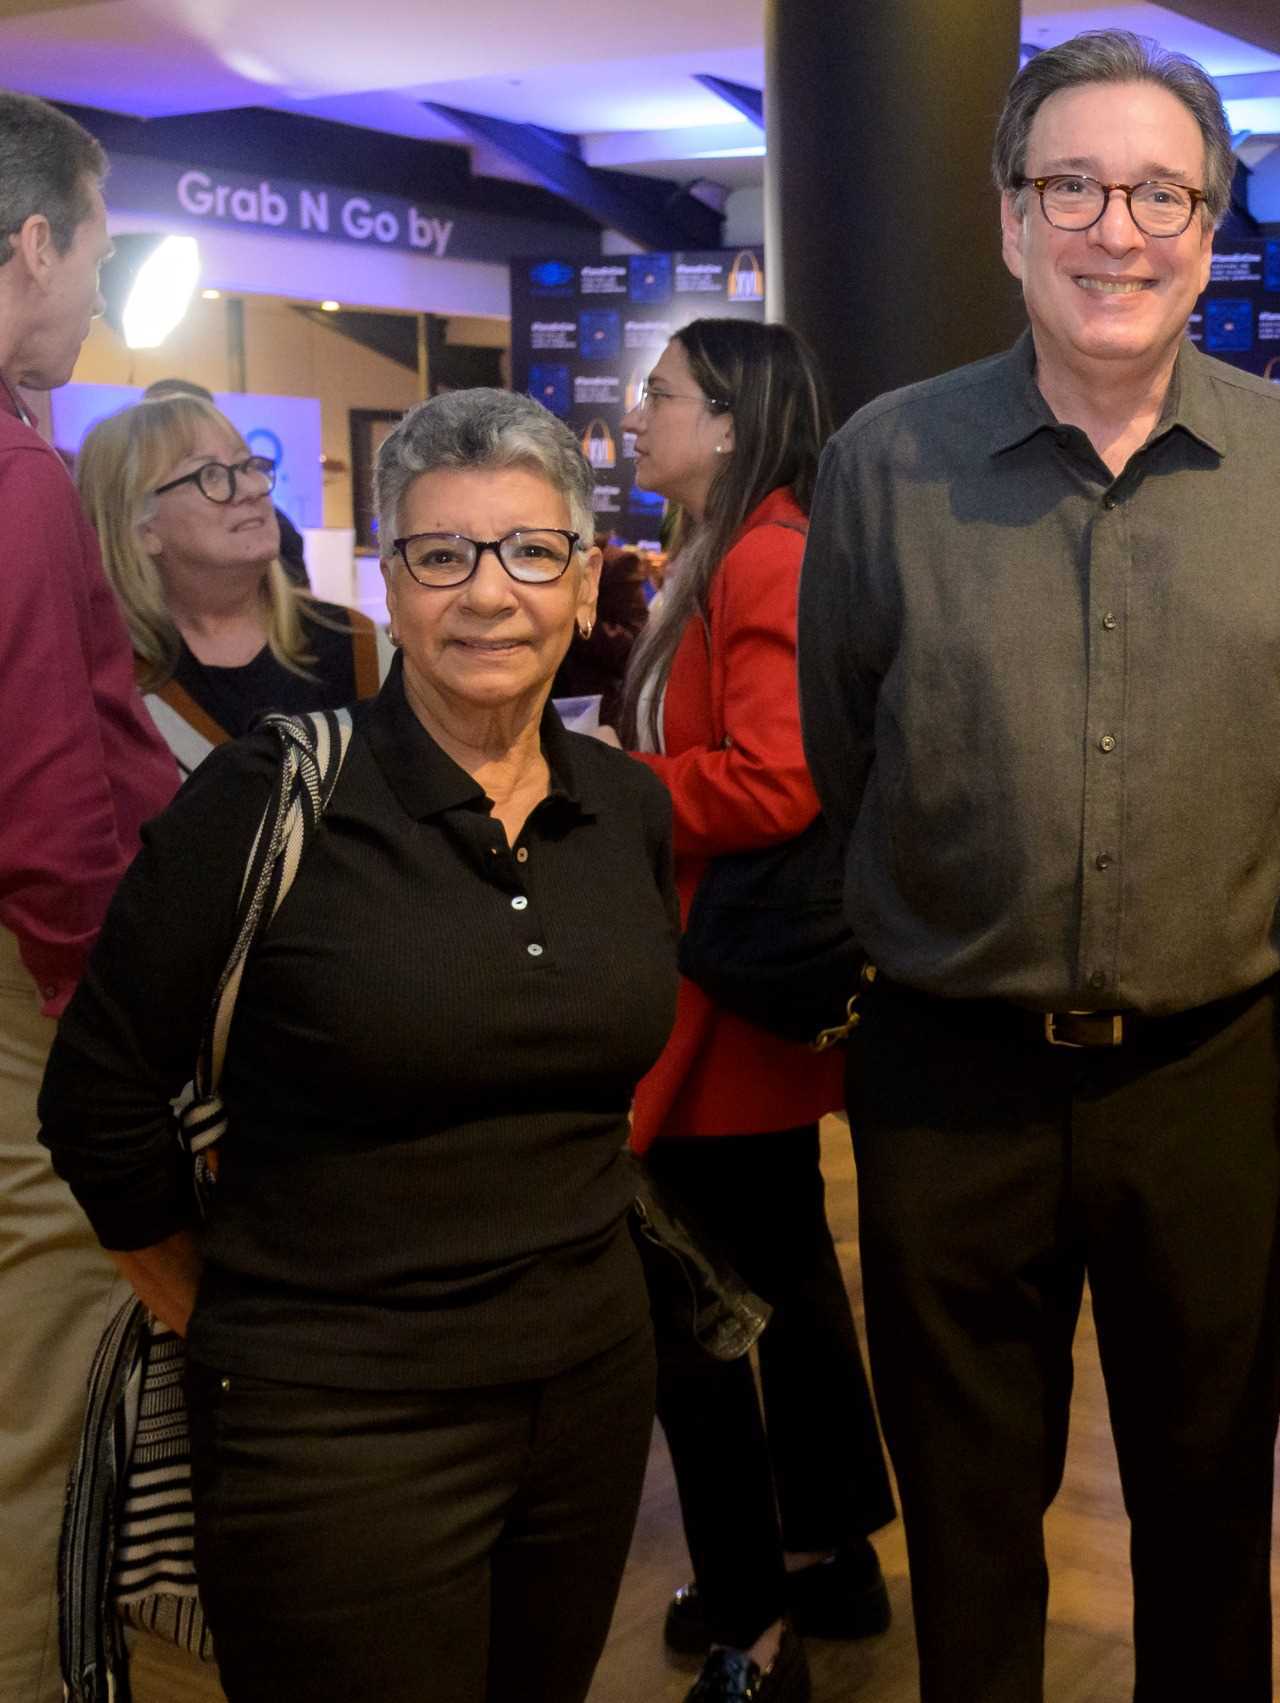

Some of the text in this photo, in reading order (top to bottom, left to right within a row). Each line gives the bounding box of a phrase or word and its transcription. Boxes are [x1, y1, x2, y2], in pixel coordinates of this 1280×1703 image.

[177, 171, 453, 257] Grab N Go by
